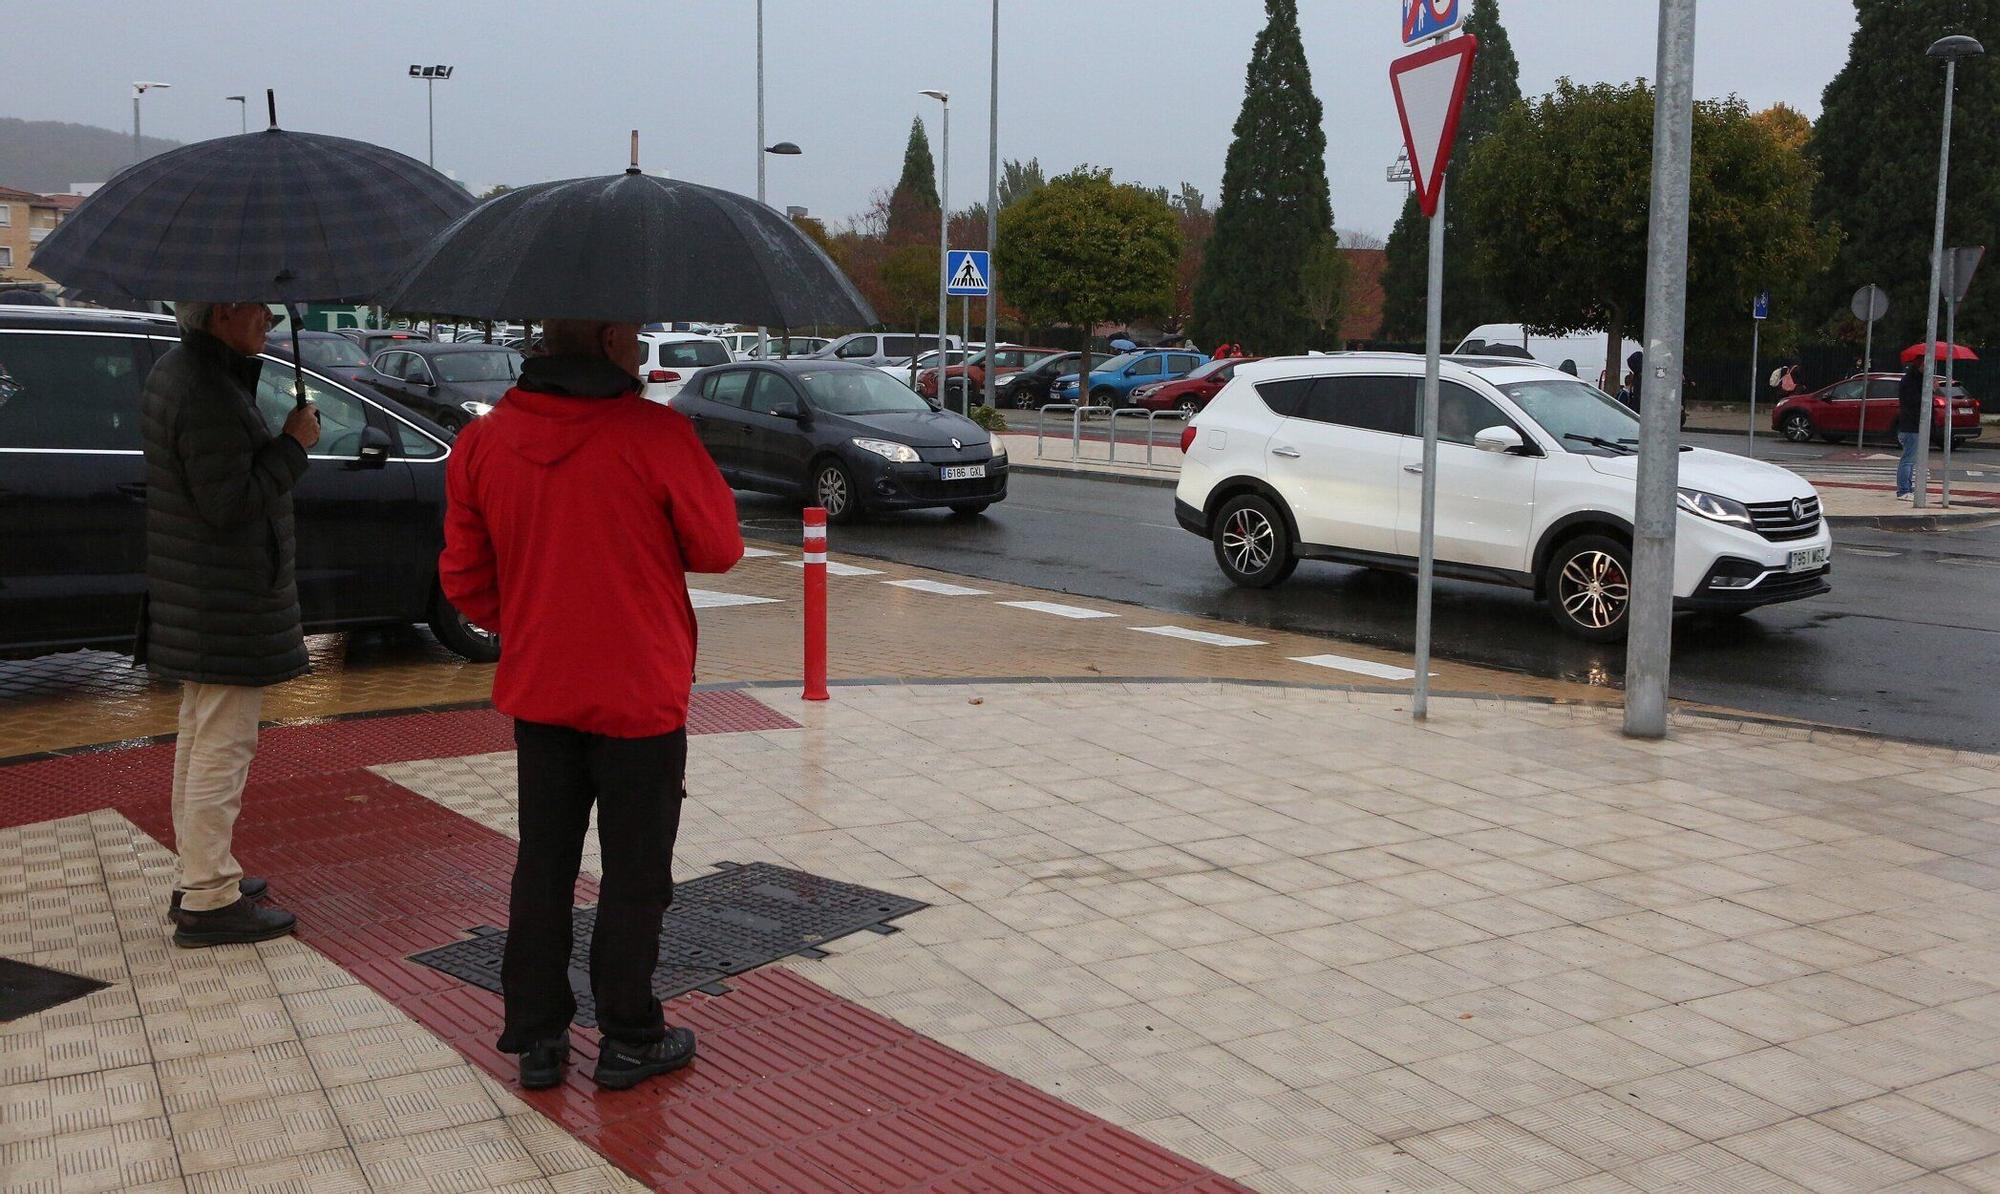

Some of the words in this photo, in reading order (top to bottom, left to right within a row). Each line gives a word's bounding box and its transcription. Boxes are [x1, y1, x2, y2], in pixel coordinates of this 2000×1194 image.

[947, 468, 967, 479] 6186
[970, 466, 983, 477] GXL
[1793, 551, 1810, 566] 7951
